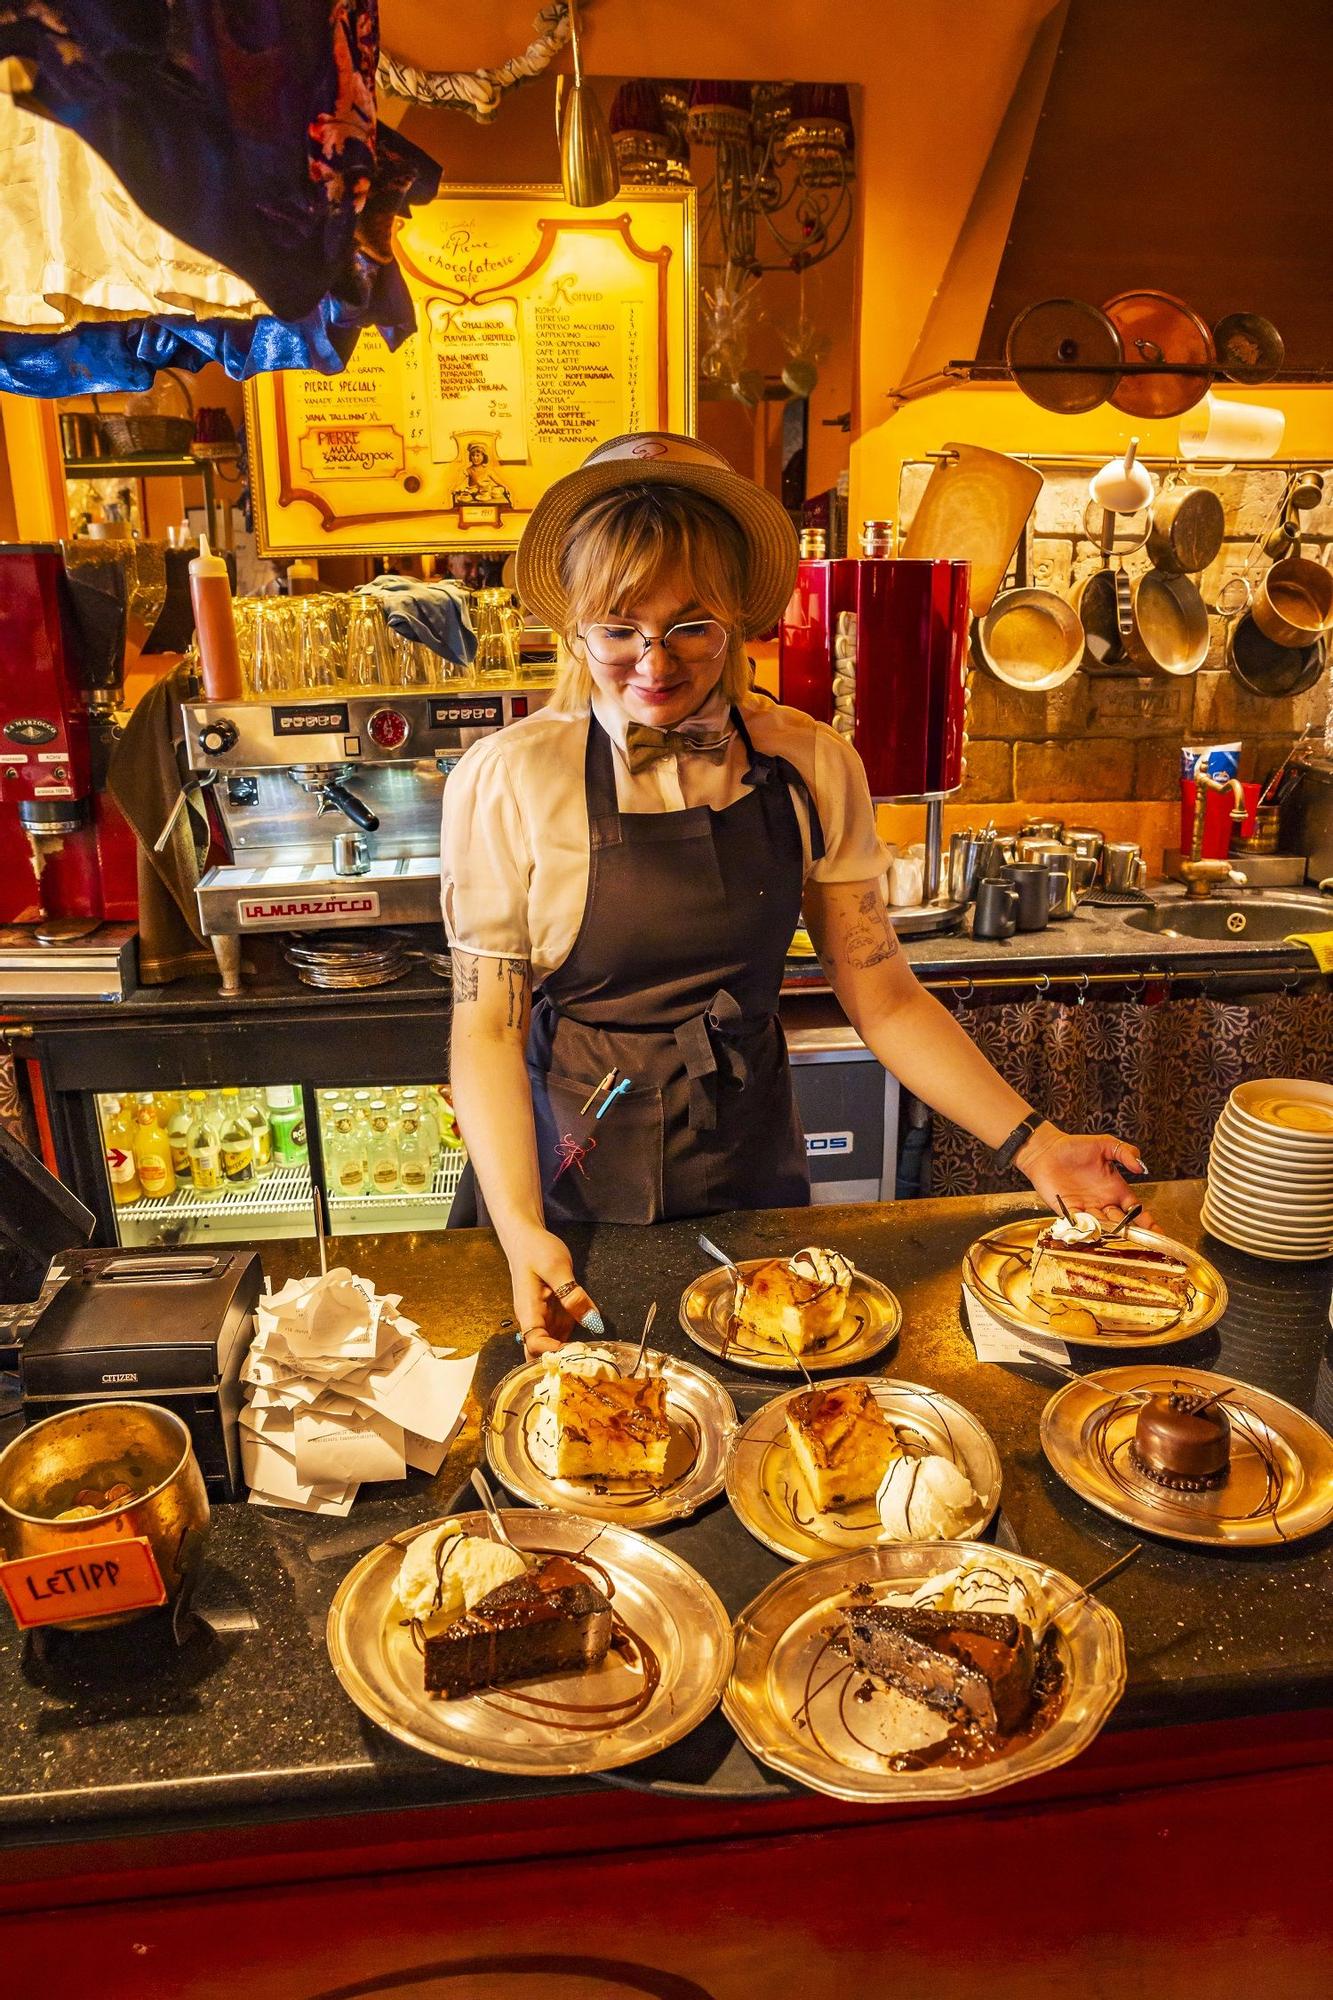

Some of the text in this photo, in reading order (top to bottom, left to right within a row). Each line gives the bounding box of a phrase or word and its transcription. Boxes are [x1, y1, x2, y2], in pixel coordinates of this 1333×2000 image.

[428, 255, 514, 273] chocolaterie
[304, 381, 376, 392] PIERRE SPECIALS
[317, 431, 361, 446] PIERRE
[329, 445, 356, 454] MAJA
[15, 719, 57, 734] MARZOCCO
[270, 899, 373, 916] MARZOCCO
[102, 1374, 138, 1383] CITIZEN
